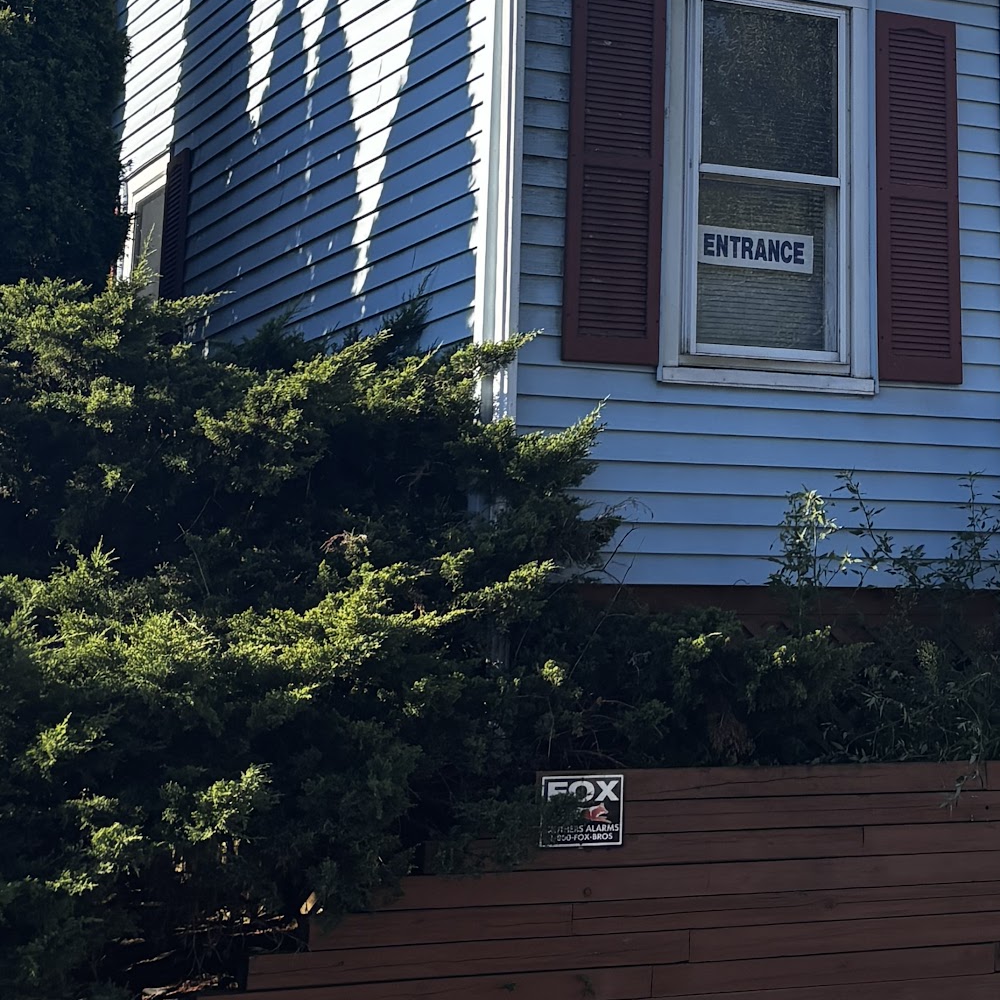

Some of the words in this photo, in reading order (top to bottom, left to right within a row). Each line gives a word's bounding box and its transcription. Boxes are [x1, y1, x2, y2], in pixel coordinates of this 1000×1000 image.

[703, 233, 805, 265] ENTRANCE
[547, 780, 620, 803] FOX
[585, 823, 619, 833] ALARMS
